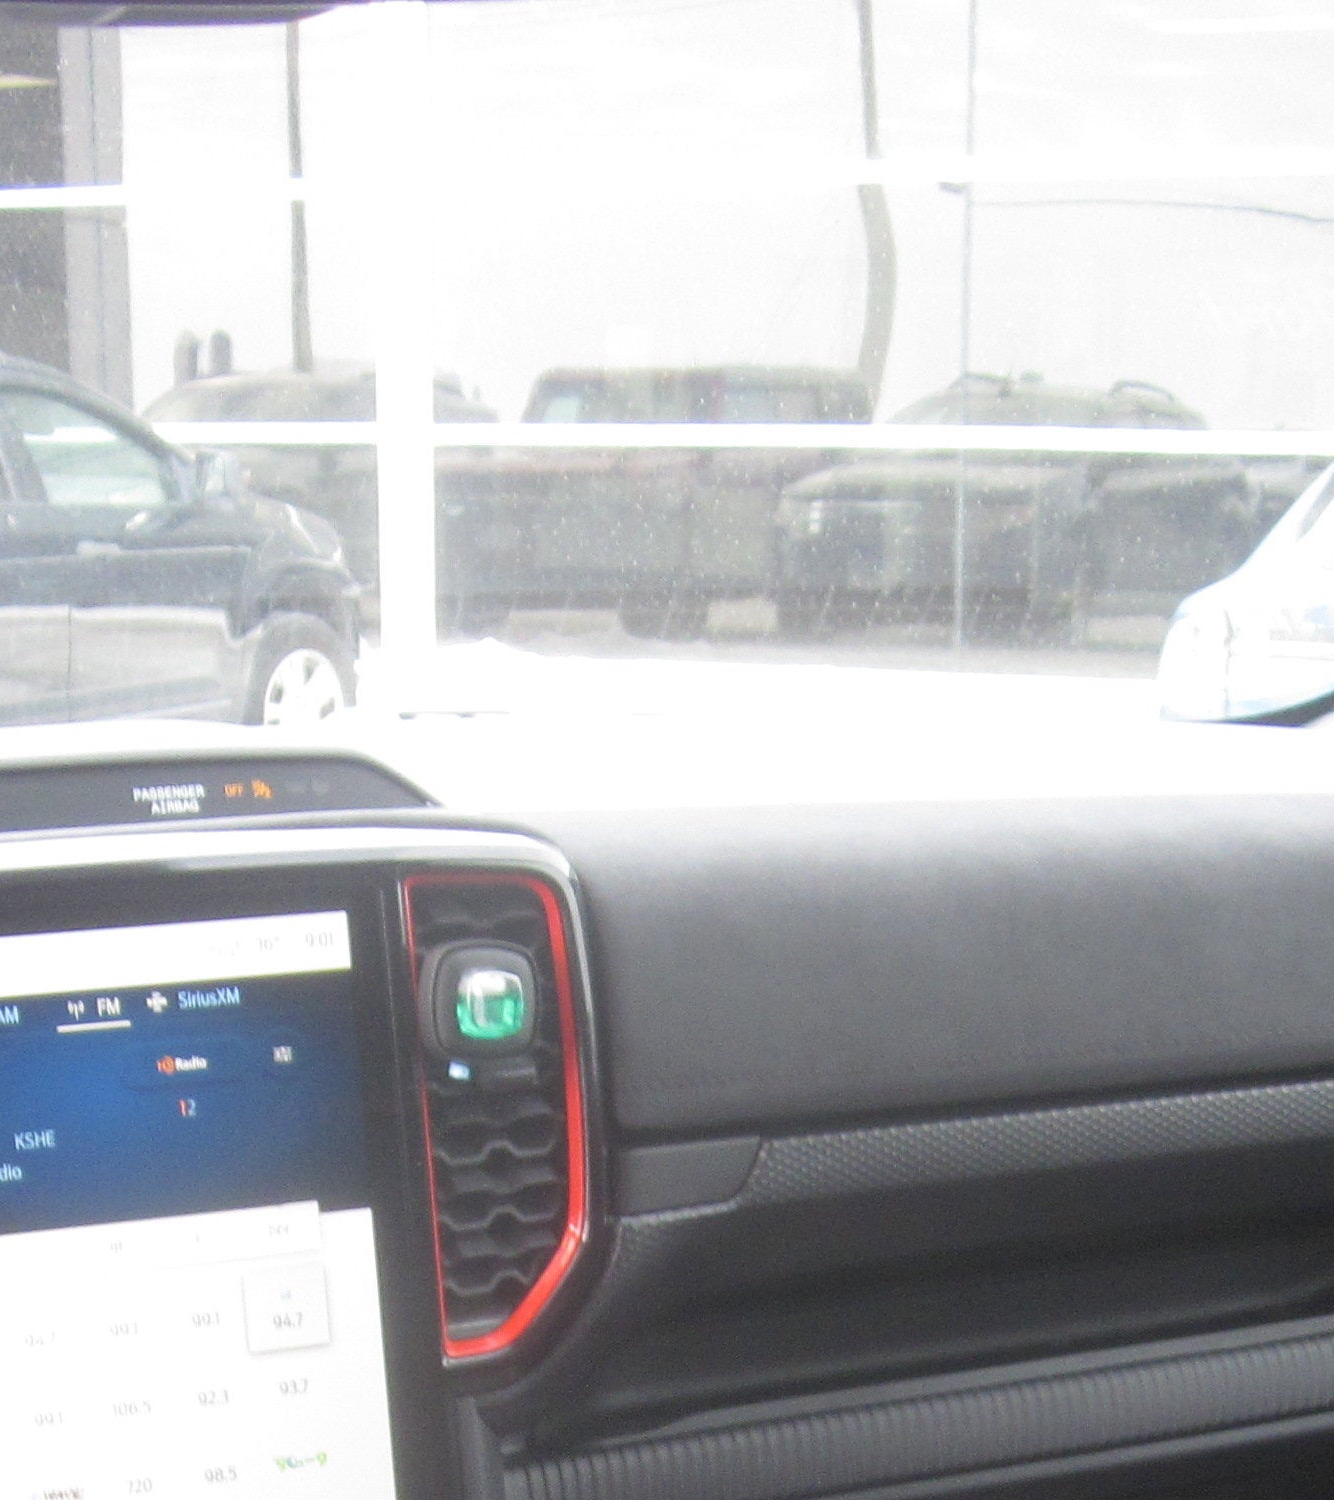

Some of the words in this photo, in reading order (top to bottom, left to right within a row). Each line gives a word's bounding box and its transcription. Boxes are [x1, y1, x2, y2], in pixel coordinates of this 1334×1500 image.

[132, 783, 205, 802] PASSENGER
[224, 783, 243, 798] OFF
[151, 799, 200, 815] AIRBAG
[178, 986, 240, 1009] SiriusXM
[96, 996, 121, 1017] FM
[176, 1055, 207, 1071] Radio
[14, 1129, 55, 1151] KSHE
[273, 1312, 303, 1328] 94.7
